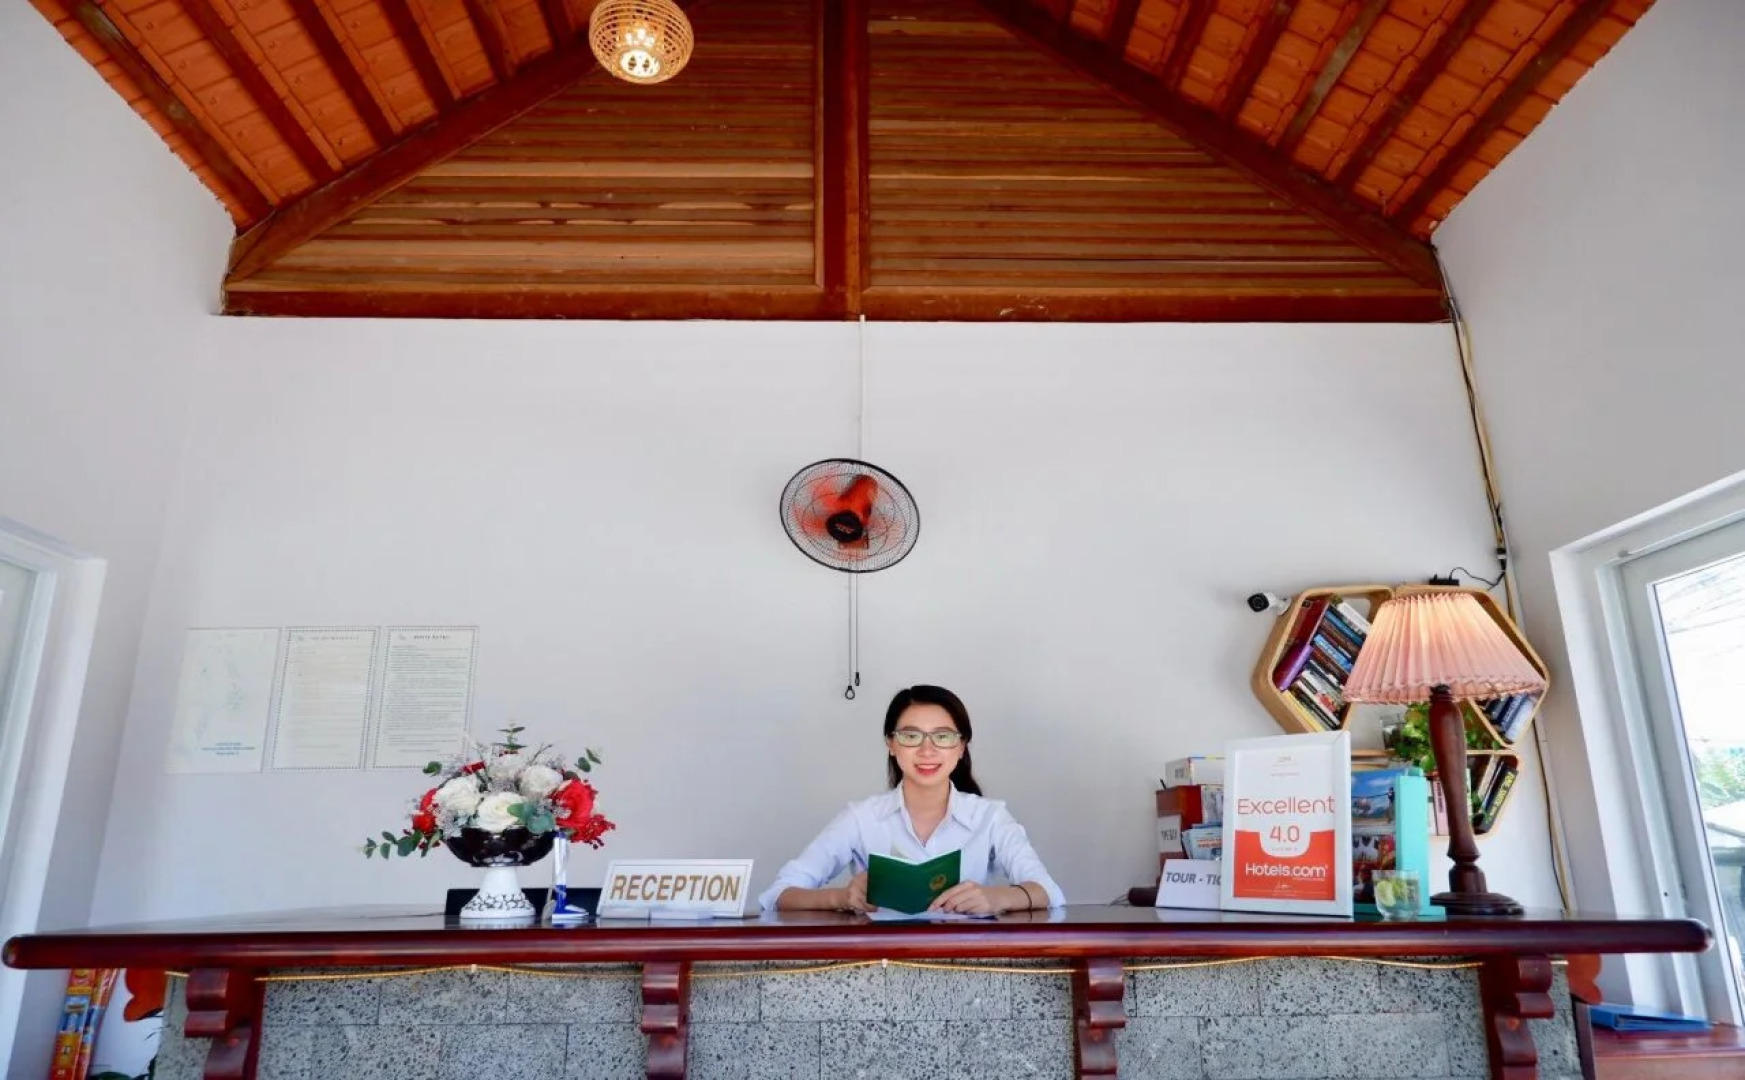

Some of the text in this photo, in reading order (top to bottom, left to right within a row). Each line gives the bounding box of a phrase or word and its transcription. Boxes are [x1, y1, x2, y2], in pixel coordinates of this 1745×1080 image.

[1237, 796, 1335, 815] Excellent
[1270, 825, 1300, 842] 4.0
[1166, 872, 1197, 884] TOUR
[610, 874, 740, 901] RECEPTION
